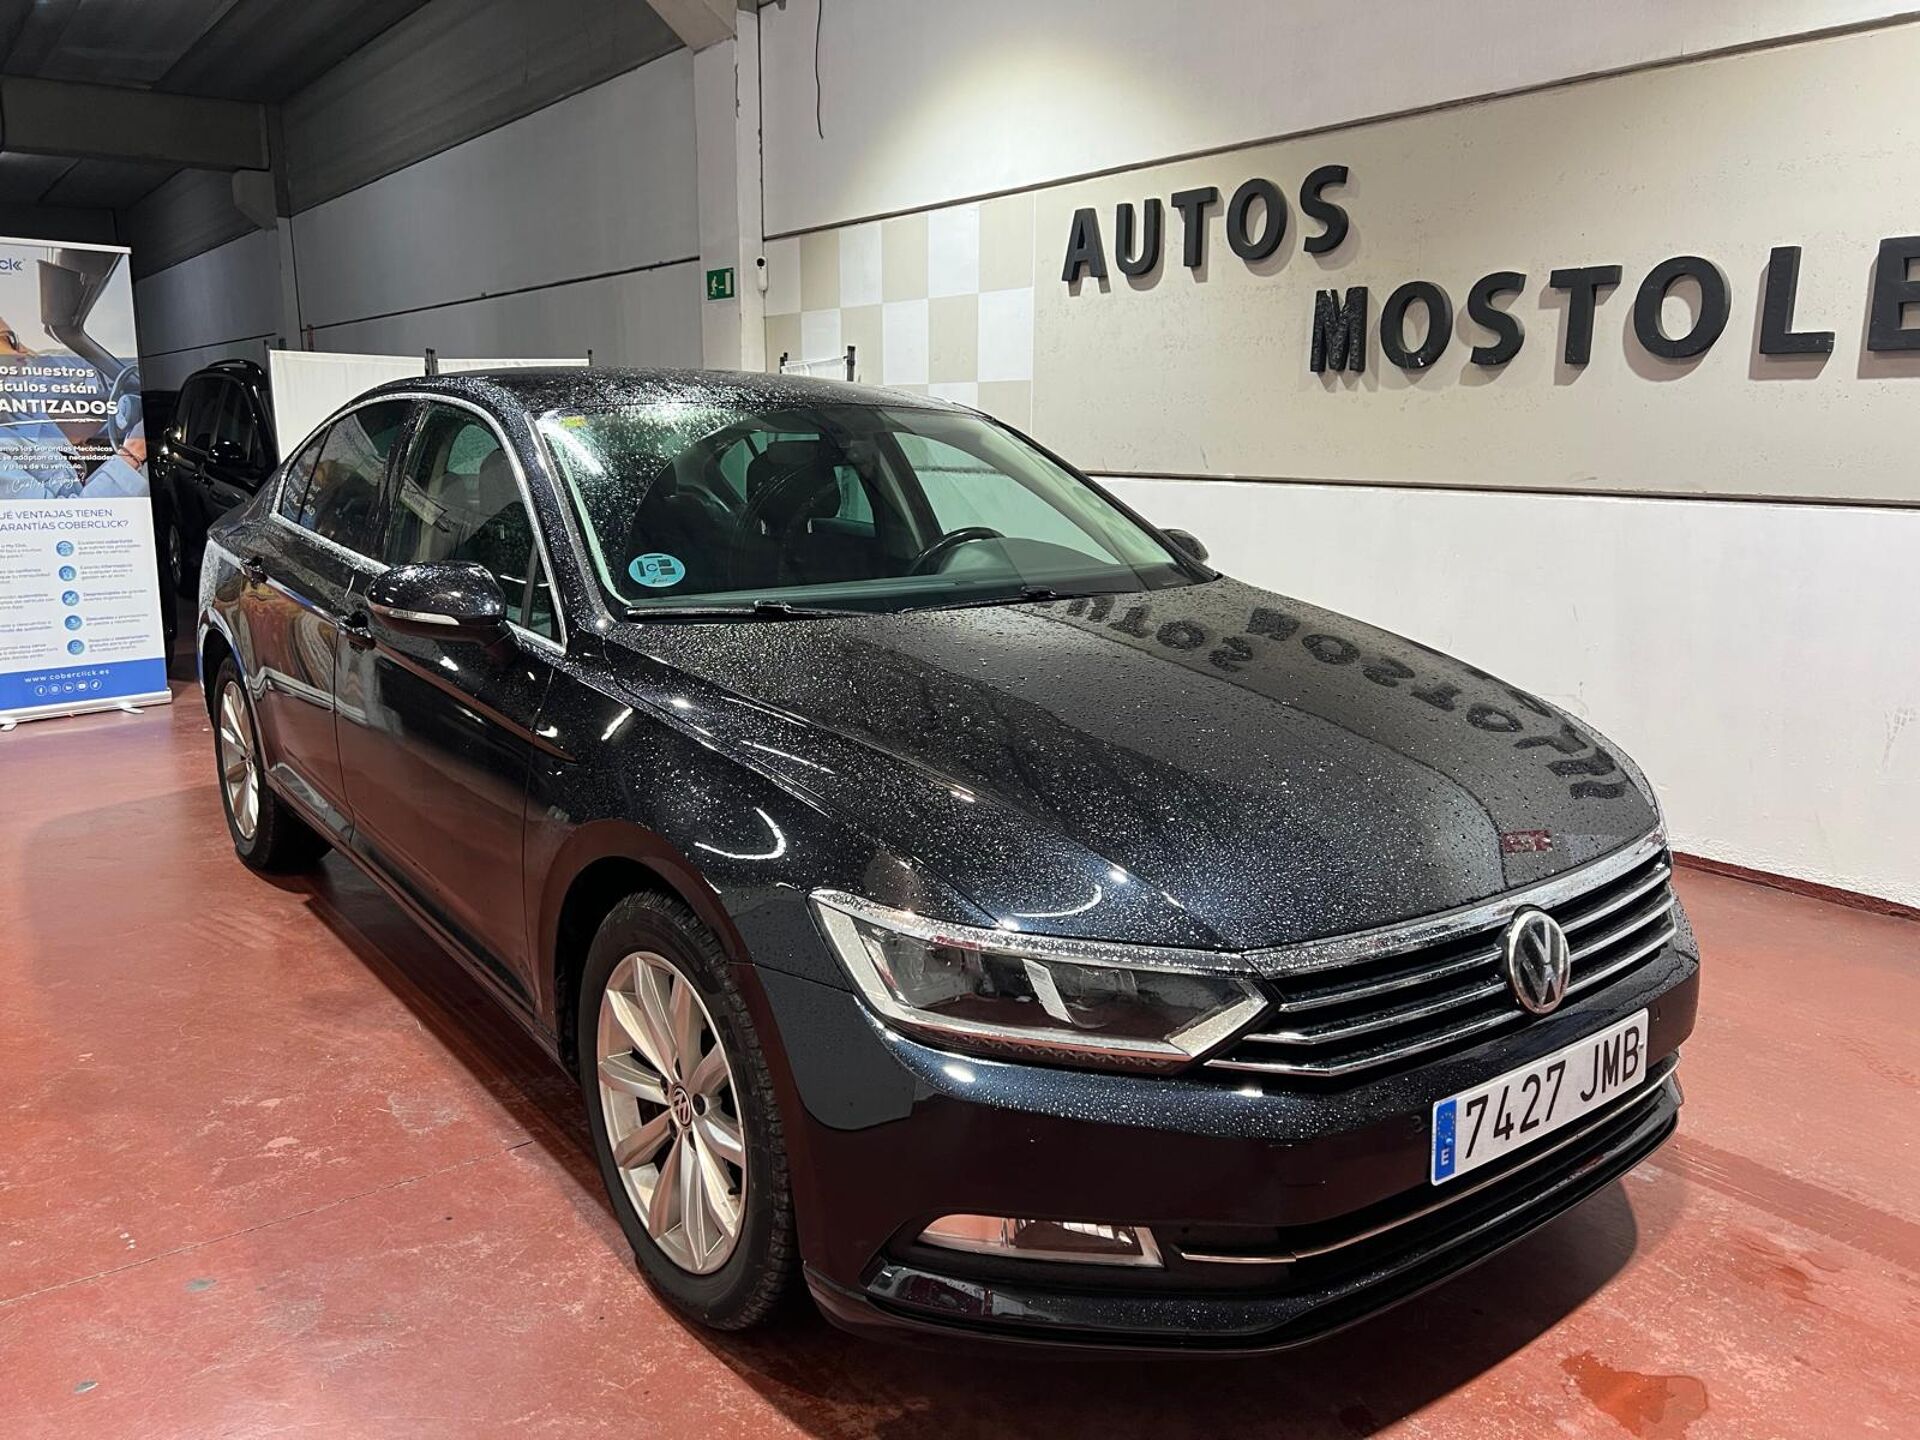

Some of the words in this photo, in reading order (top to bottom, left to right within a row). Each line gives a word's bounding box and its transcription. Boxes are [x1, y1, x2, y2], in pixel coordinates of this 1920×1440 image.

[1060, 164, 1350, 282] AUTOS
[1310, 235, 1920, 375] MOSTOLE
[22, 366, 95, 378] nuestros
[51, 382, 97, 395] están
[0, 398, 118, 415] ANTIZADOS
[15, 509, 73, 519] VENTAJAS
[75, 508, 113, 518] TIENEN
[58, 520, 129, 530] COBERCLICK?
[646, 563, 658, 572] C
[1465, 1059, 1567, 1160] 7427
[1580, 1025, 1641, 1102] JMB
[1440, 1150, 1450, 1166] E
